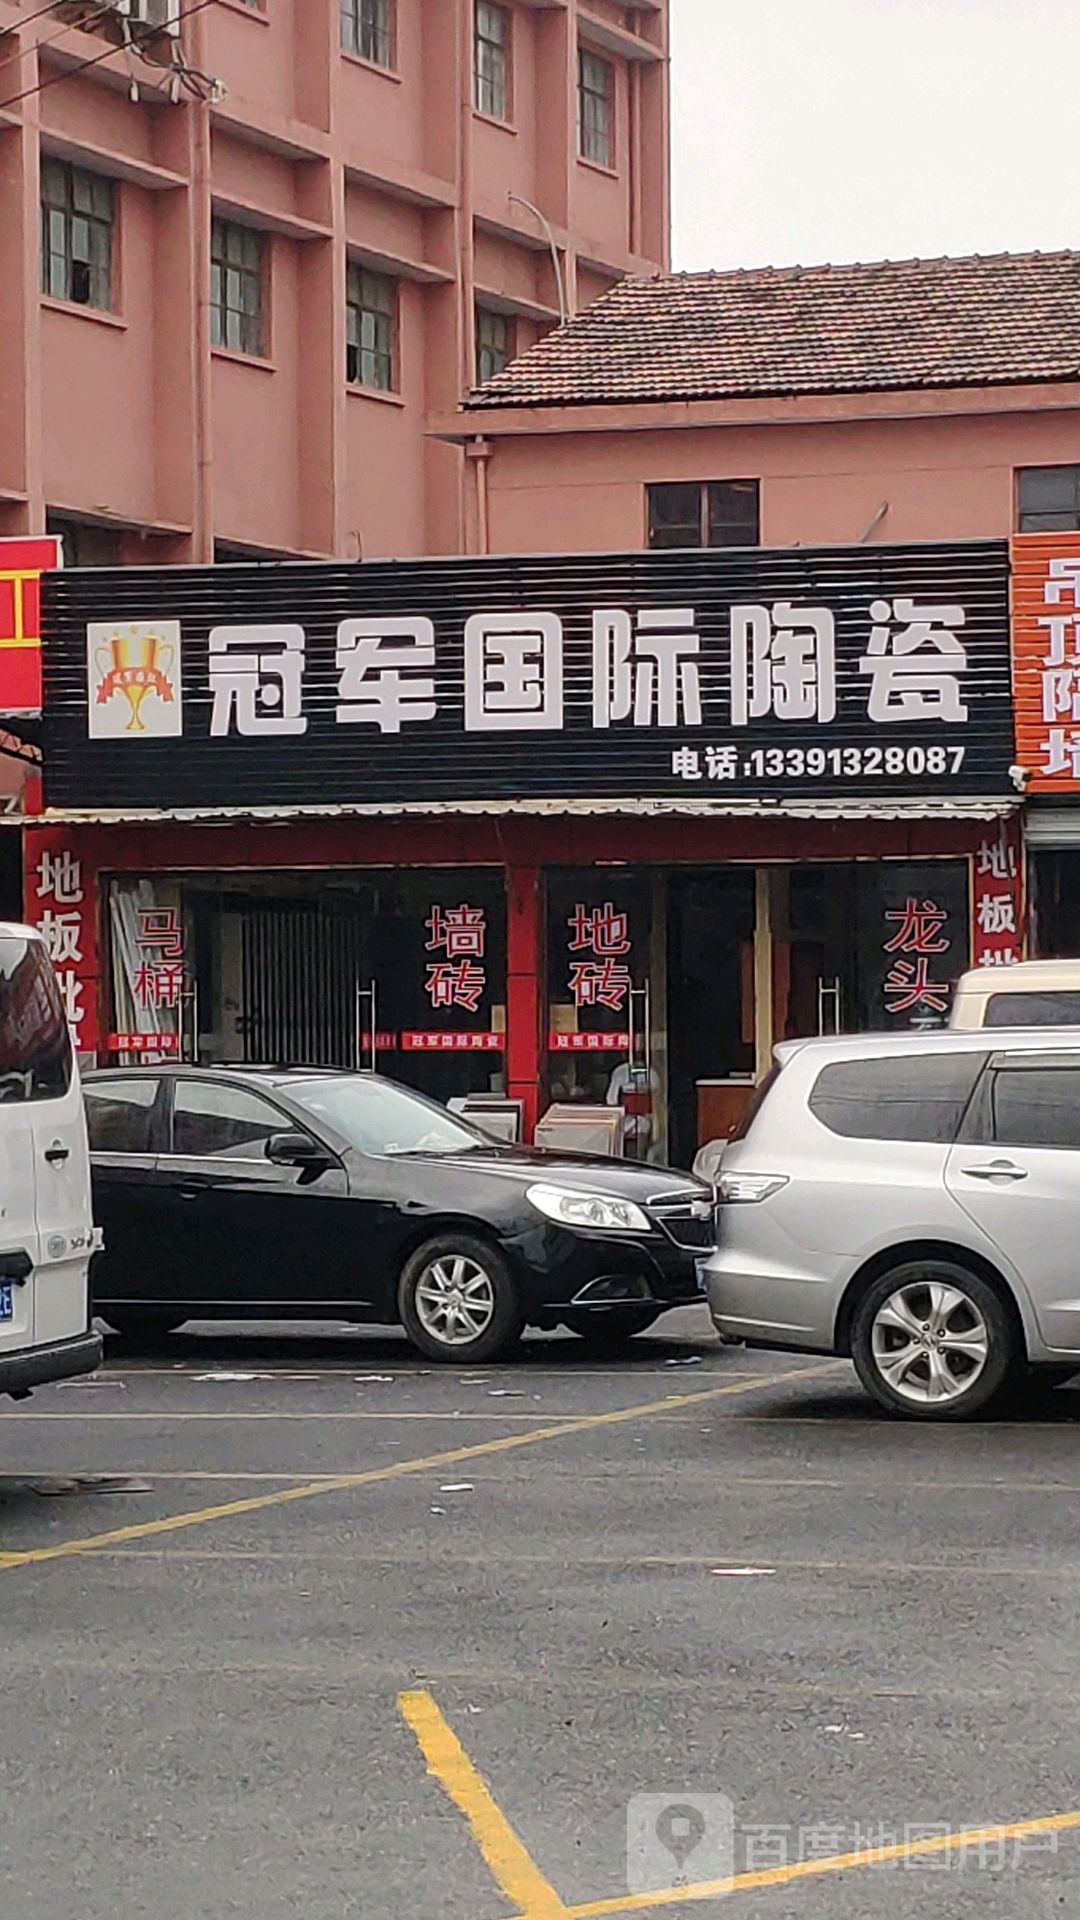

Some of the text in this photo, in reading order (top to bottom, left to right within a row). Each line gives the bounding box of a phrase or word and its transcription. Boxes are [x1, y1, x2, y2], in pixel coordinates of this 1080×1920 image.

[208, 599, 969, 736] 冠军国际陶瓷
[134, 906, 187, 1009] 马桶
[425, 904, 487, 1013] 墙砖
[567, 902, 632, 1011] 地砖
[884, 897, 950, 1013] 龙头
